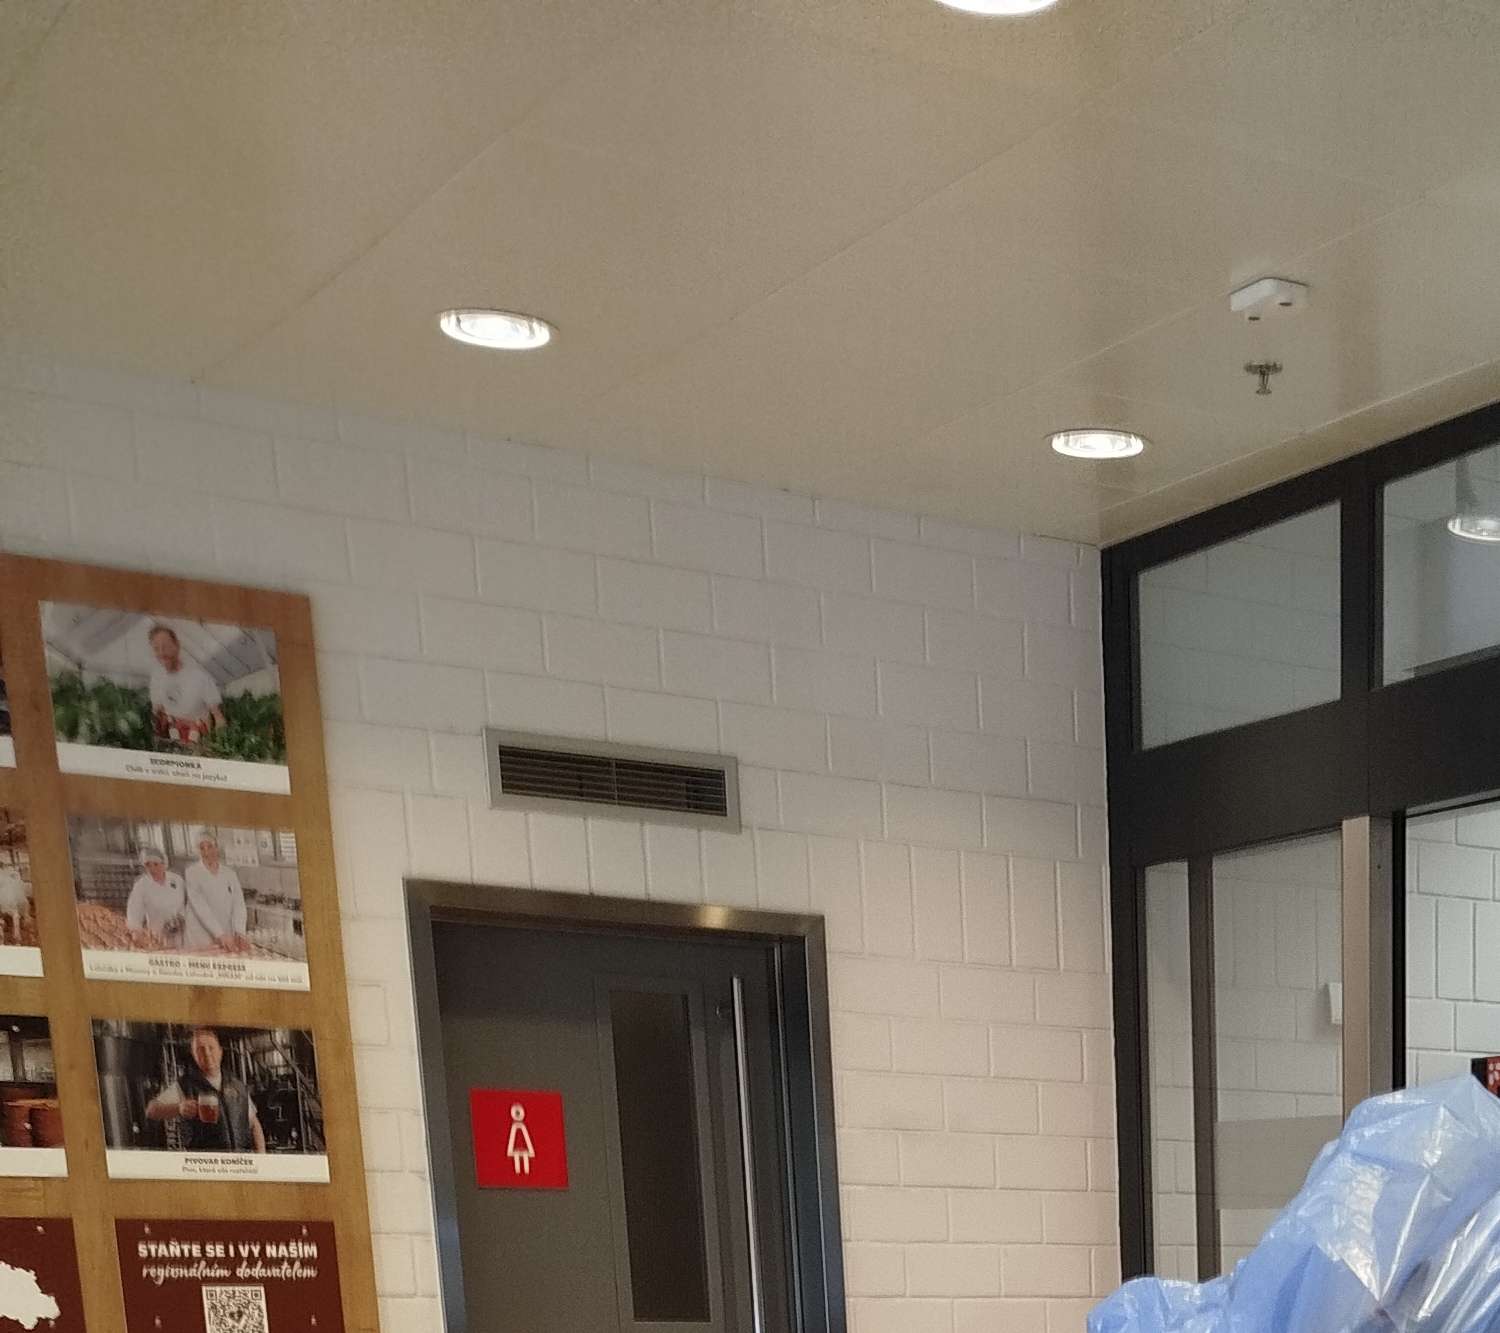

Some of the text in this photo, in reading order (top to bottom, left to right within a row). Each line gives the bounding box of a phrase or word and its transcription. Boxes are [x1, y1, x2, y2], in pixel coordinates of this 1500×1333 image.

[138, 1238, 318, 1259] STAŇTE SE I VY NAŠÍM
[142, 1261, 318, 1285] regionálním dodavatelem
